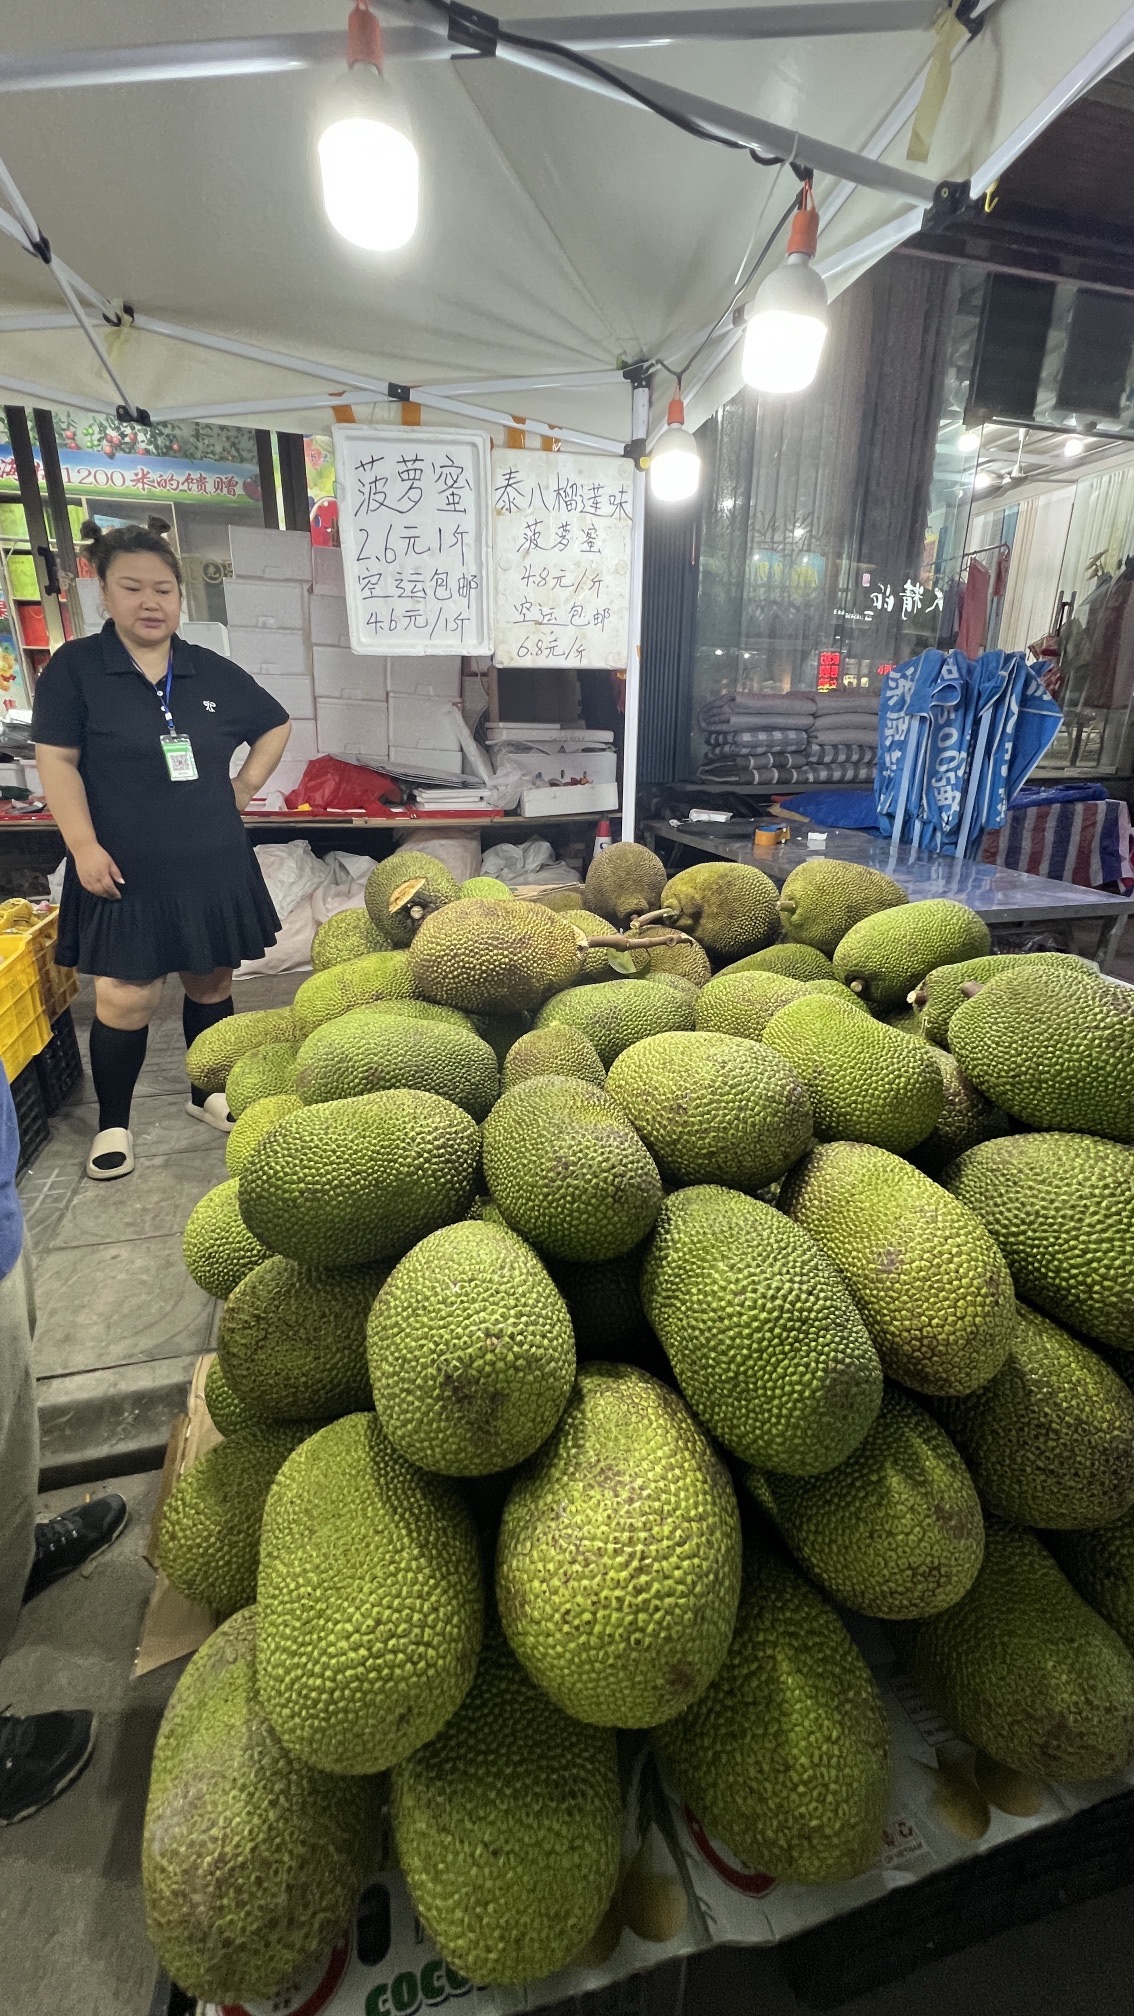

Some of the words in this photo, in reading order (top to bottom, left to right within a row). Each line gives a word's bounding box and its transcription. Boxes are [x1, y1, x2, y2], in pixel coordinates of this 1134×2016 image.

[354, 453, 472, 516] 菠萝蜜
[517, 518, 602, 554] 菠萝蜜
[358, 567, 478, 609] 空运包邮
[513, 595, 611, 632] 空运包邮
